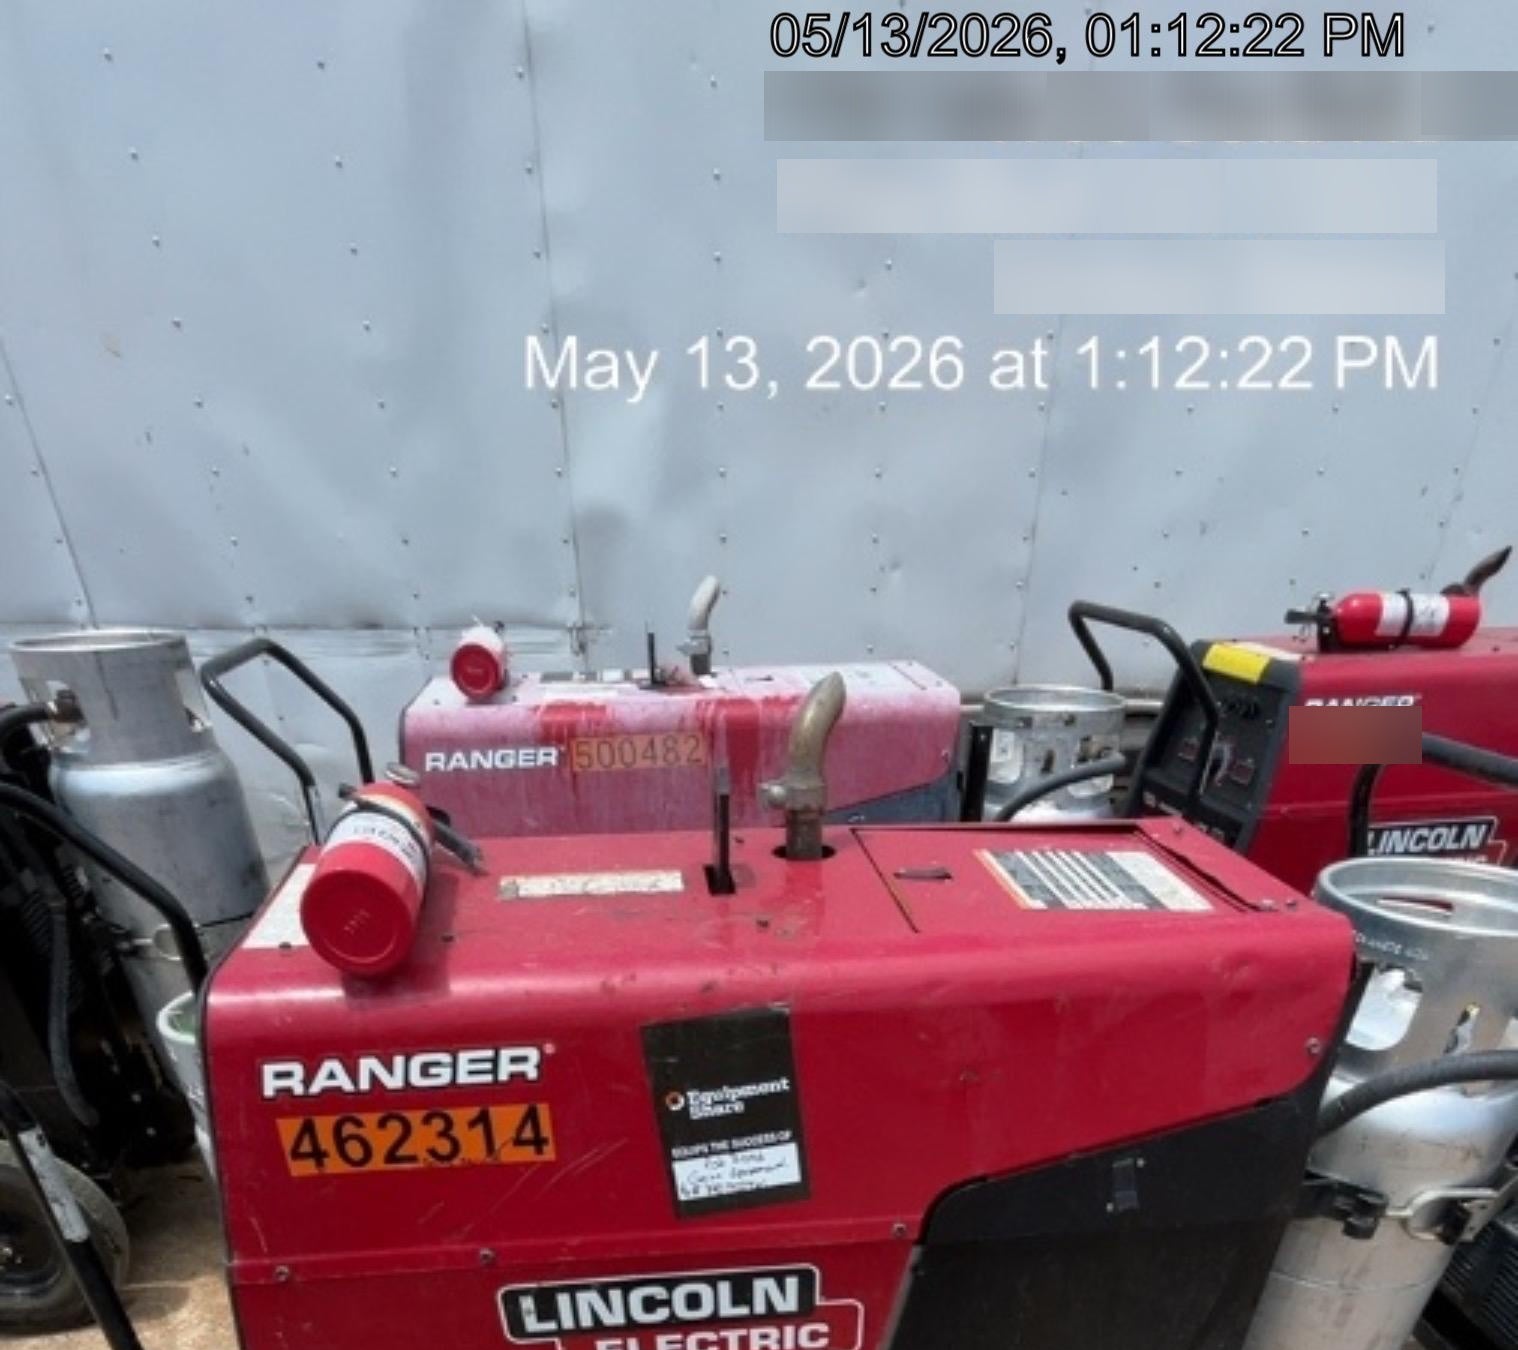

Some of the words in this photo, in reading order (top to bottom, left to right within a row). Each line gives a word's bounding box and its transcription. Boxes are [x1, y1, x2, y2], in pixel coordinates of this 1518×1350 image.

[425, 747, 559, 771] RANGER
[573, 734, 702, 768] 500482
[261, 1046, 541, 1098] RANGER
[290, 1104, 549, 1169] 462314
[518, 1276, 799, 1333] LINCOLN
